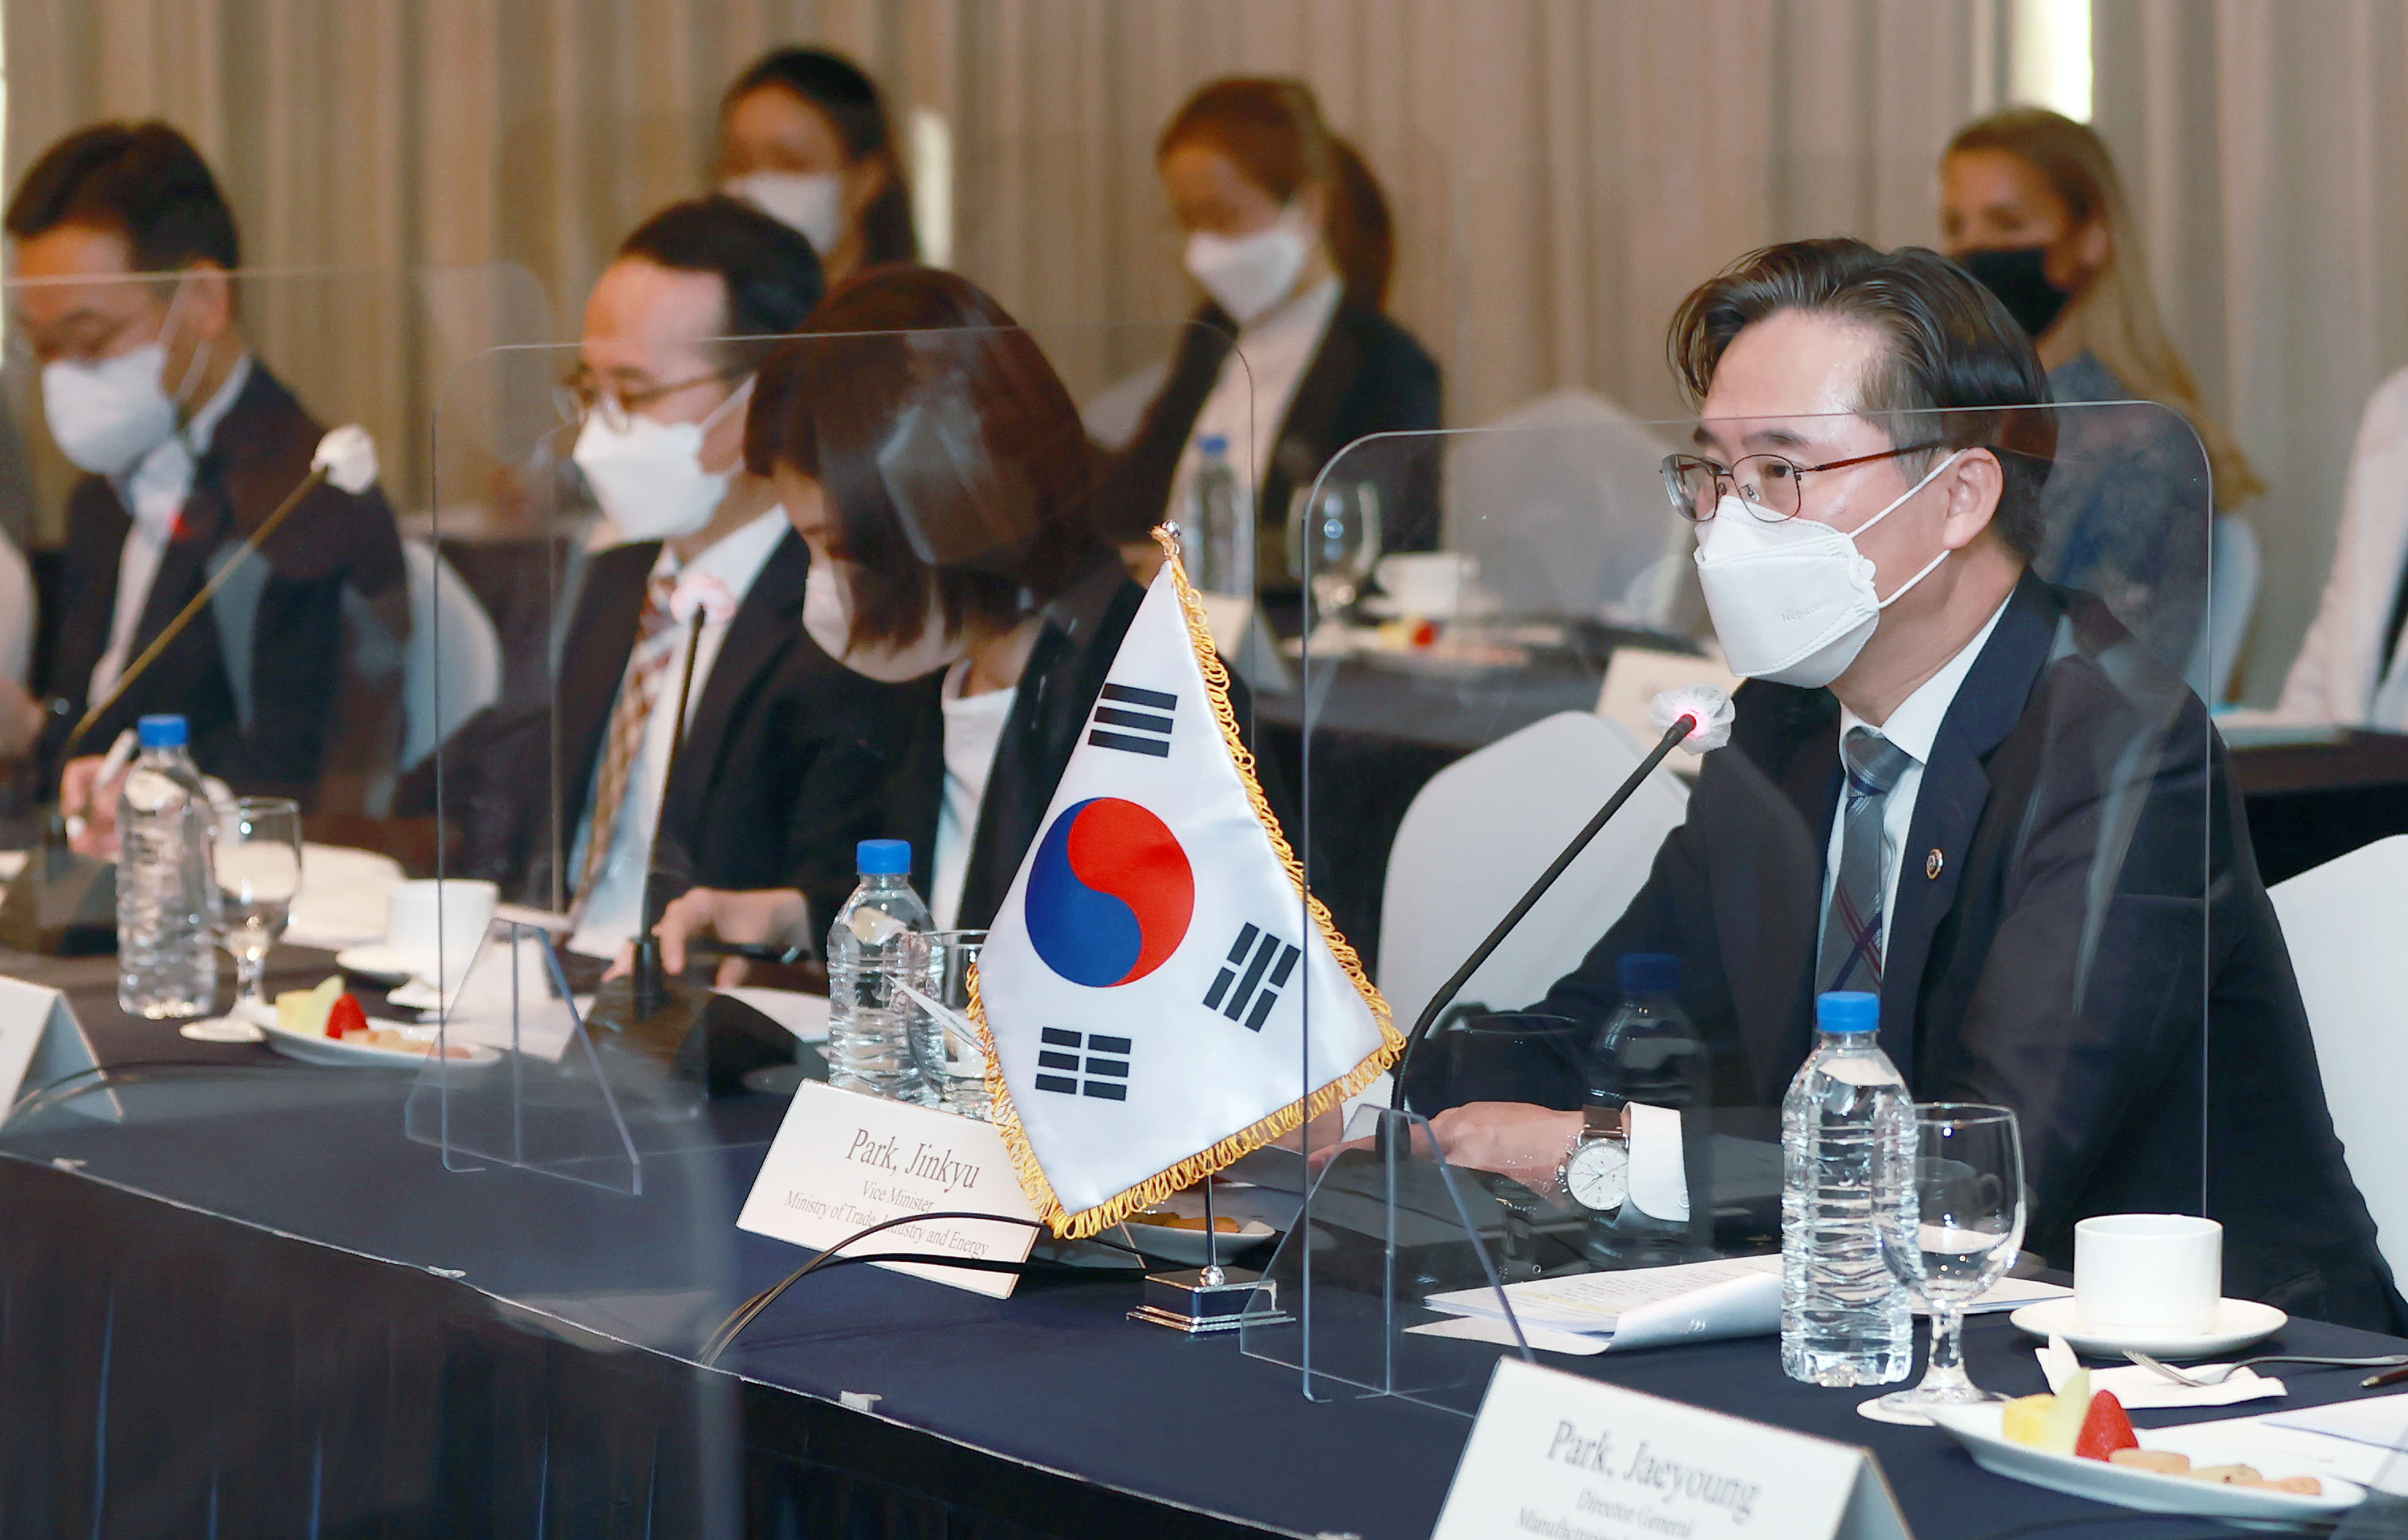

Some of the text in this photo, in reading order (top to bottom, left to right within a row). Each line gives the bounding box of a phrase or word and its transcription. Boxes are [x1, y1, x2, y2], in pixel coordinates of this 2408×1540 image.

[845, 1128, 981, 1194] Park, Jinkyu
[783, 1190, 830, 1220] Ministry
[830, 1203, 848, 1221] of
[925, 1229, 950, 1246] and
[948, 1231, 990, 1259] Energy
[861, 1180, 935, 1213] Vice Minister
[1547, 1419, 1762, 1526] Park, Jaeyoung
[1575, 1487, 1696, 1540] Director General
